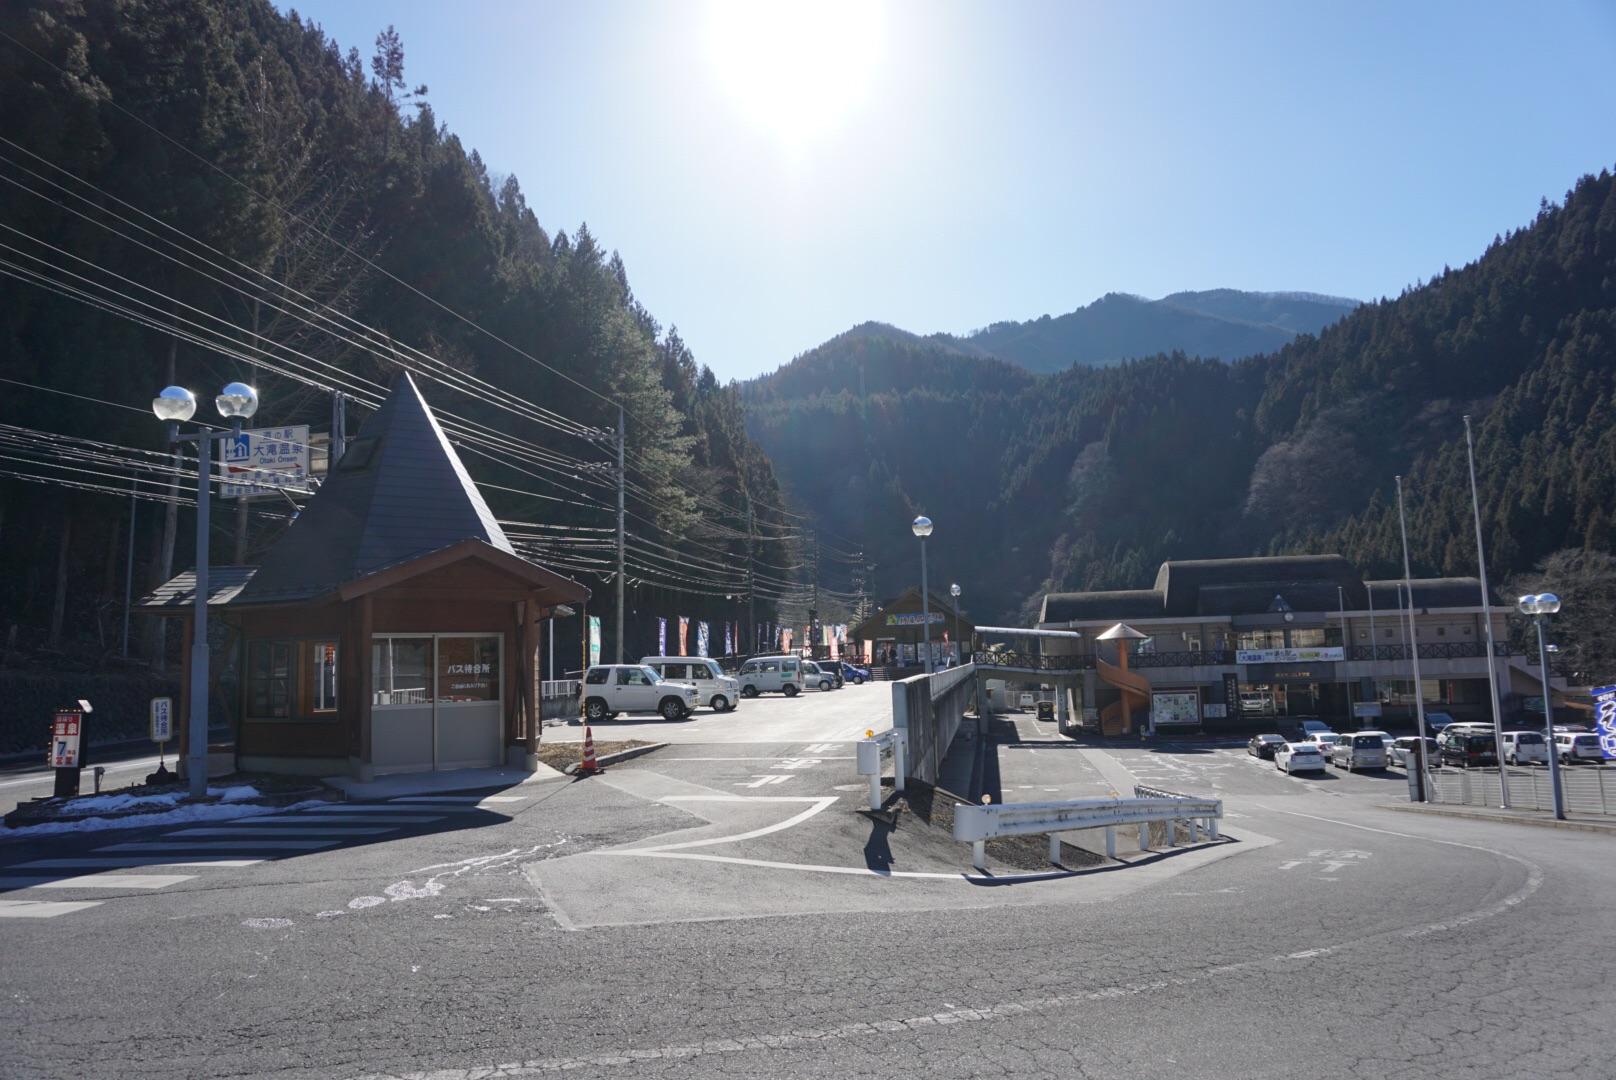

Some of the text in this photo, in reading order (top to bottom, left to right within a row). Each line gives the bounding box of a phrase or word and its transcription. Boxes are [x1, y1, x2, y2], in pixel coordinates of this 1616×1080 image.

[254, 442, 304, 457] 大滝温泉
[447, 663, 490, 674] バス待合所
[160, 701, 168, 736] バス待合所
[55, 722, 78, 735] 温泉
[57, 741, 67, 756] 7
